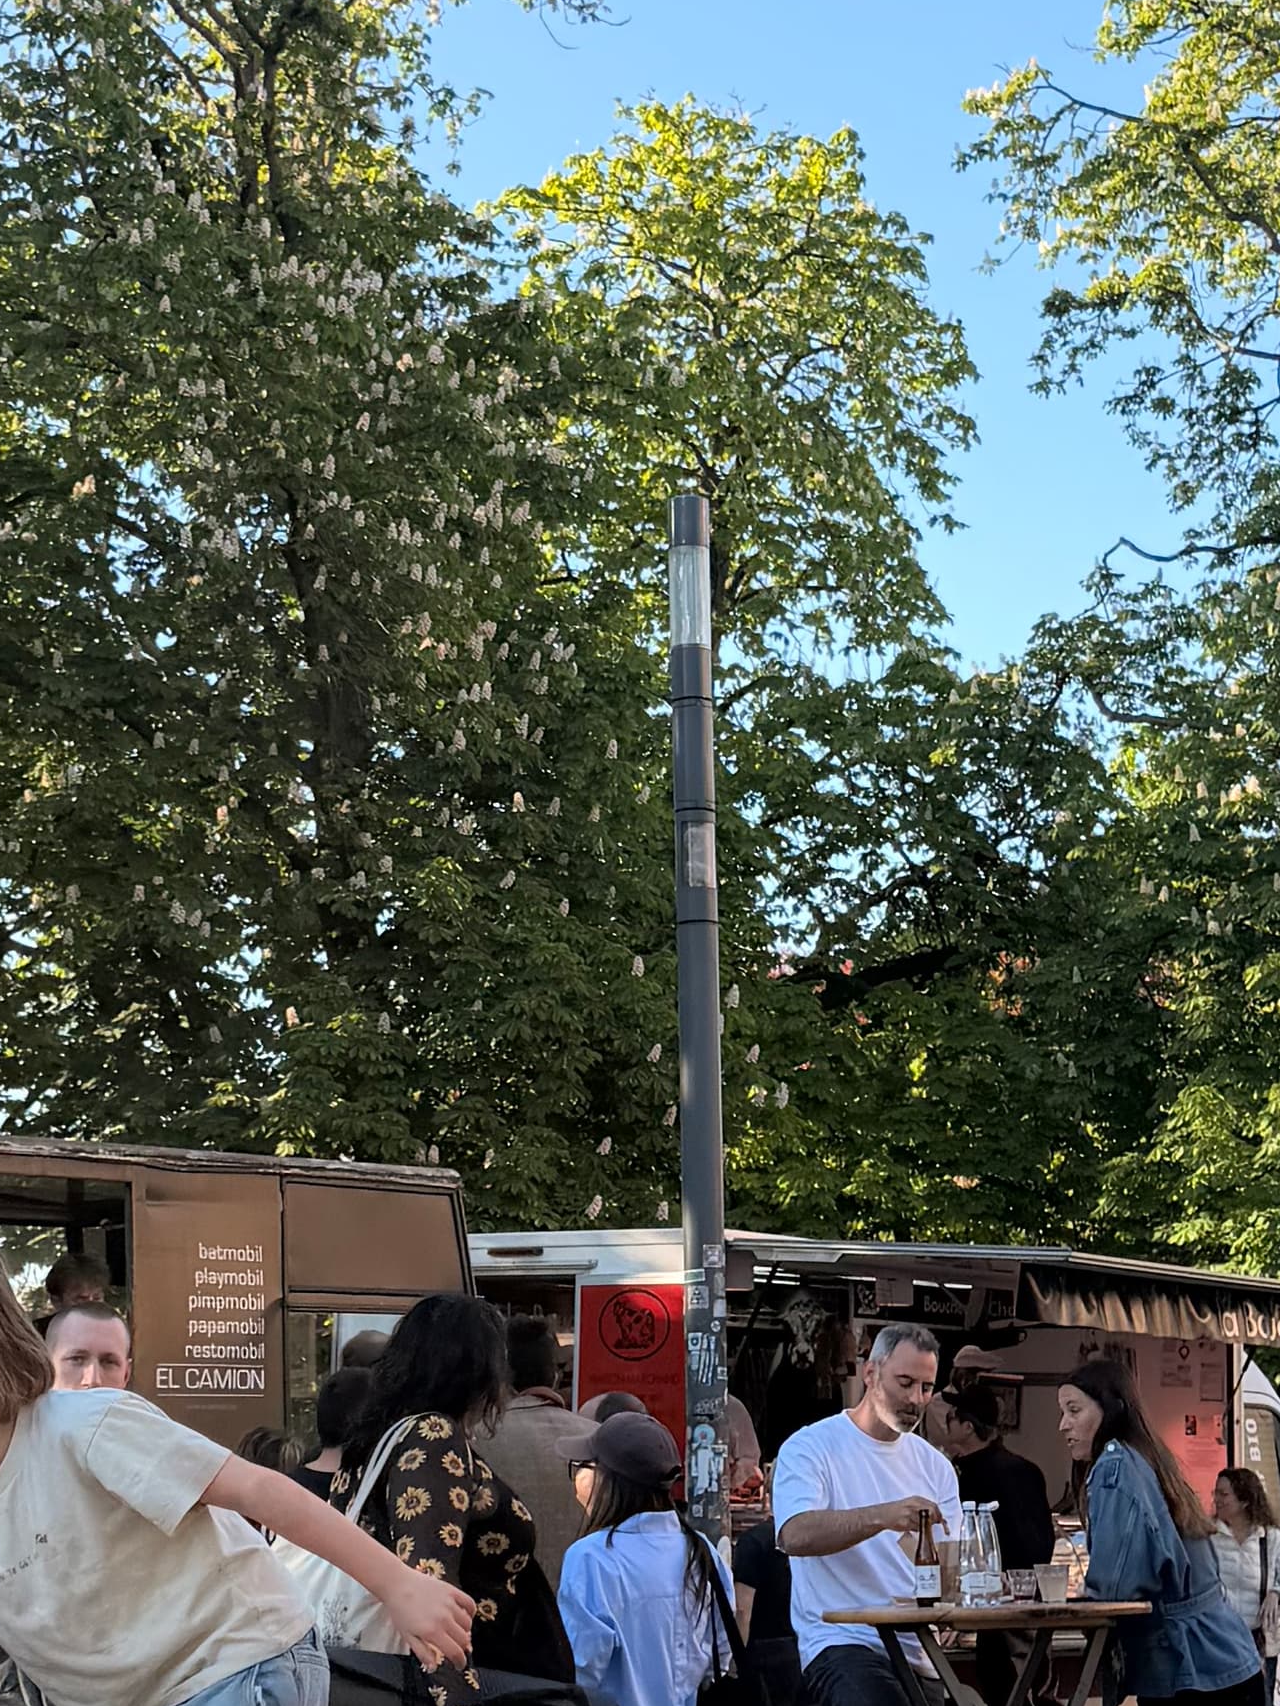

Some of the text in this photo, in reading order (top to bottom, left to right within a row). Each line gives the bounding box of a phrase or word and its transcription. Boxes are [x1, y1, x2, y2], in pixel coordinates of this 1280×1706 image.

[198, 1242, 263, 1263] batmobil
[195, 1267, 264, 1290] playmobil
[188, 1291, 265, 1314] pimpmobil
[188, 1318, 265, 1338] papamobil
[185, 1343, 265, 1359] restomobil
[156, 1367, 265, 1390] EL CAMION
